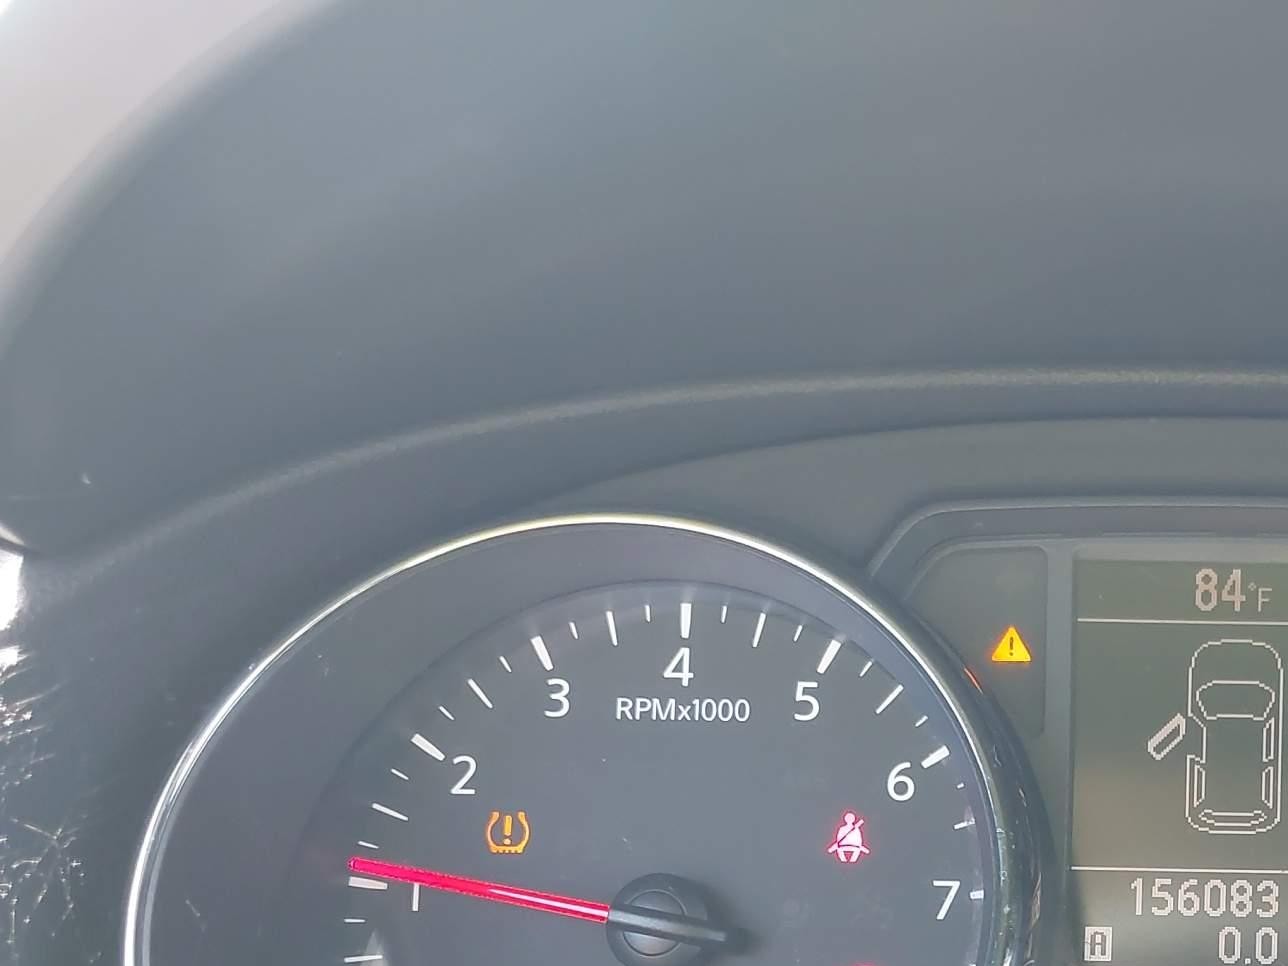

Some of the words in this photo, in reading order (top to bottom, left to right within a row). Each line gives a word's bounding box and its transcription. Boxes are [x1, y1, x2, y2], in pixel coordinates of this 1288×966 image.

[663, 647, 694, 686] 4
[543, 678, 571, 717] 3
[615, 697, 751, 723] RPMx1000
[794, 681, 820, 721] 5
[450, 756, 477, 795] 2
[886, 762, 915, 802] 6
[932, 881, 961, 920] 7
[1130, 878, 1280, 918] 156083
[1218, 927, 1278, 965] 0.0
